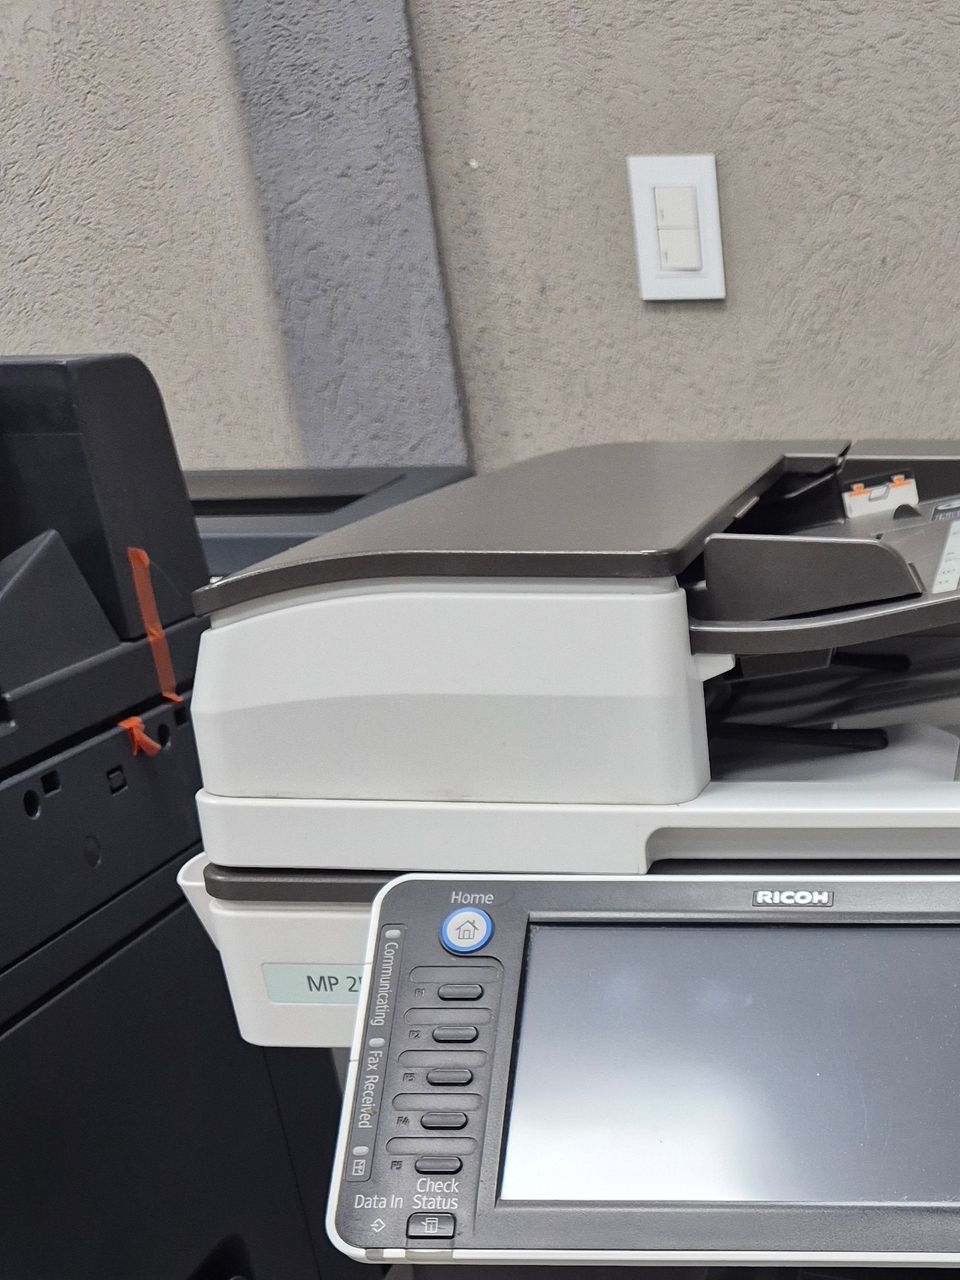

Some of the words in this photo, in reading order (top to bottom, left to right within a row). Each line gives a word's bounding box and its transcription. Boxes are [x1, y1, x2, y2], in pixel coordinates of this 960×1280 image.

[451, 891, 493, 904] Home
[756, 890, 829, 904] RICOH
[306, 976, 339, 992] MP
[346, 976, 362, 992] 2
[370, 941, 399, 1026] Communicating
[367, 1051, 383, 1071] Fax
[358, 1075, 379, 1128] Received
[416, 1178, 459, 1192] Check
[354, 1195, 387, 1209] Data
[390, 1195, 403, 1208] In
[412, 1195, 458, 1209] Status
